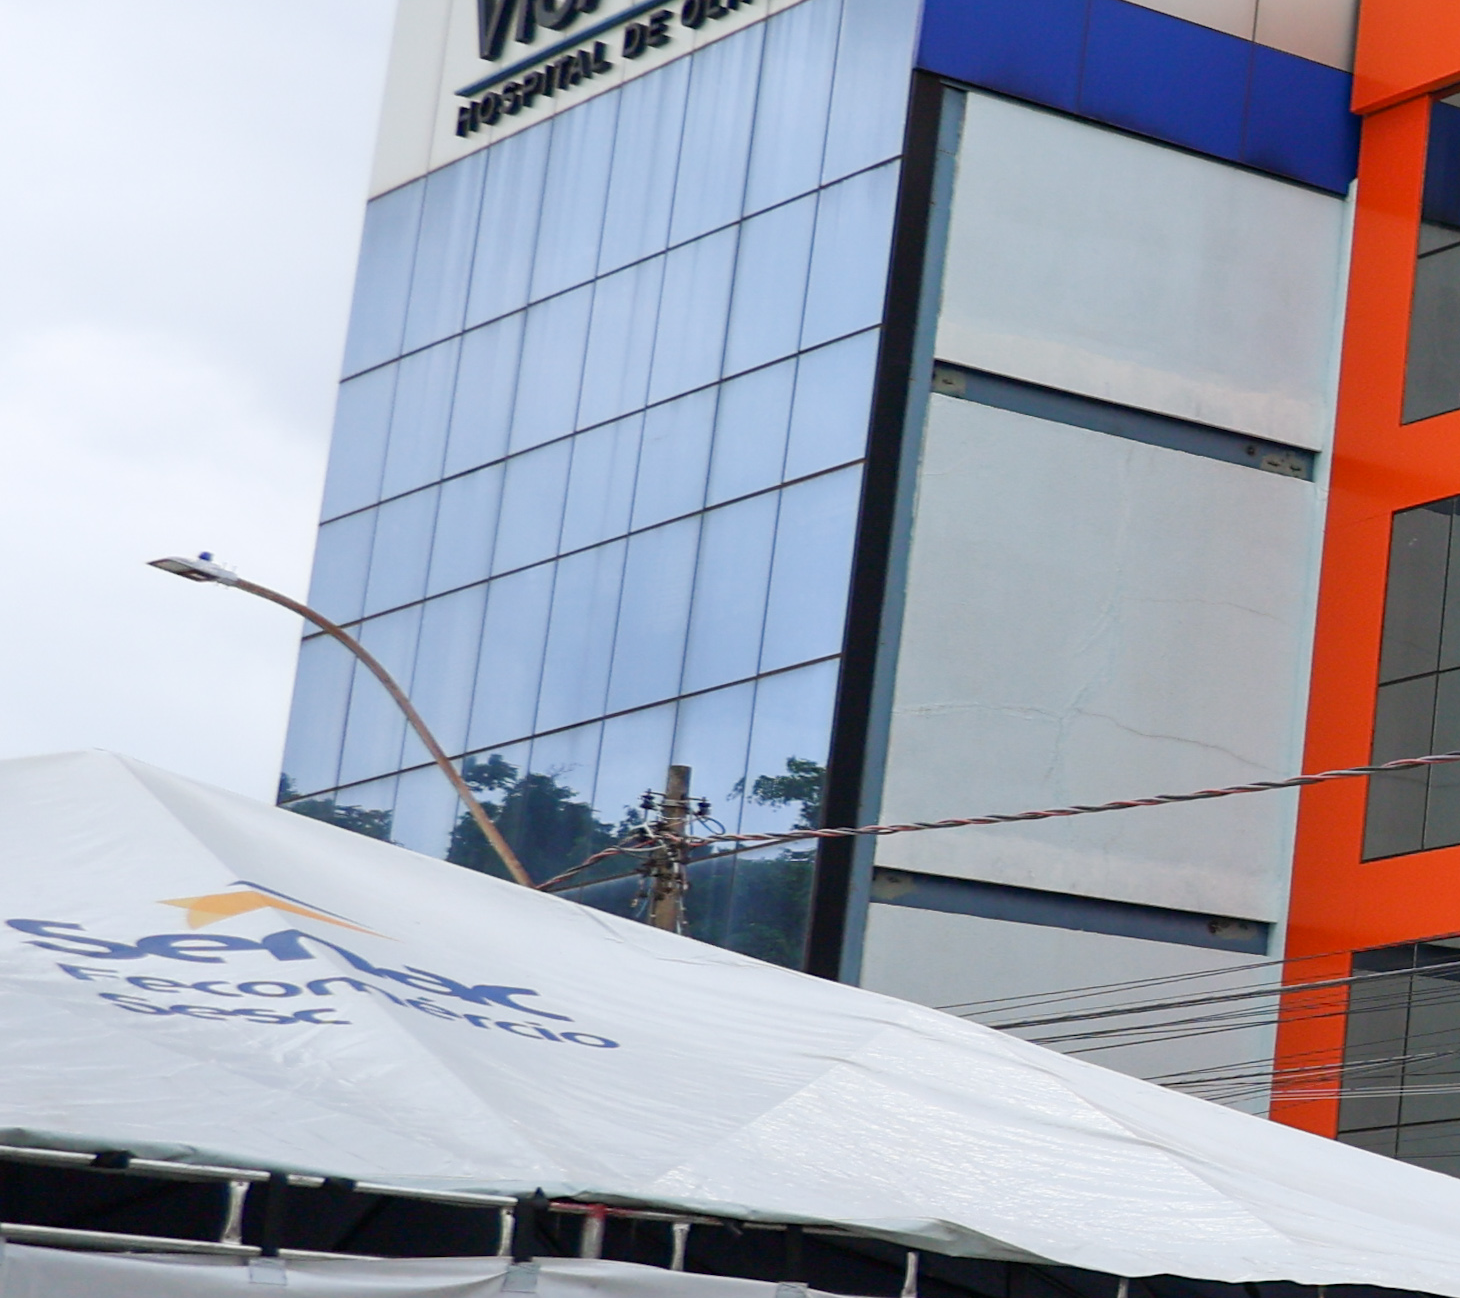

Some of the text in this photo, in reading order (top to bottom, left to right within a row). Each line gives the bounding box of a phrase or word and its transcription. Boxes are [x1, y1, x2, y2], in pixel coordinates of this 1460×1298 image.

[455, 40, 613, 138] HOSPITAL
[621, 9, 675, 60] DE
[5, 918, 575, 1022] Senac
[55, 961, 621, 1049] Fecomércio
